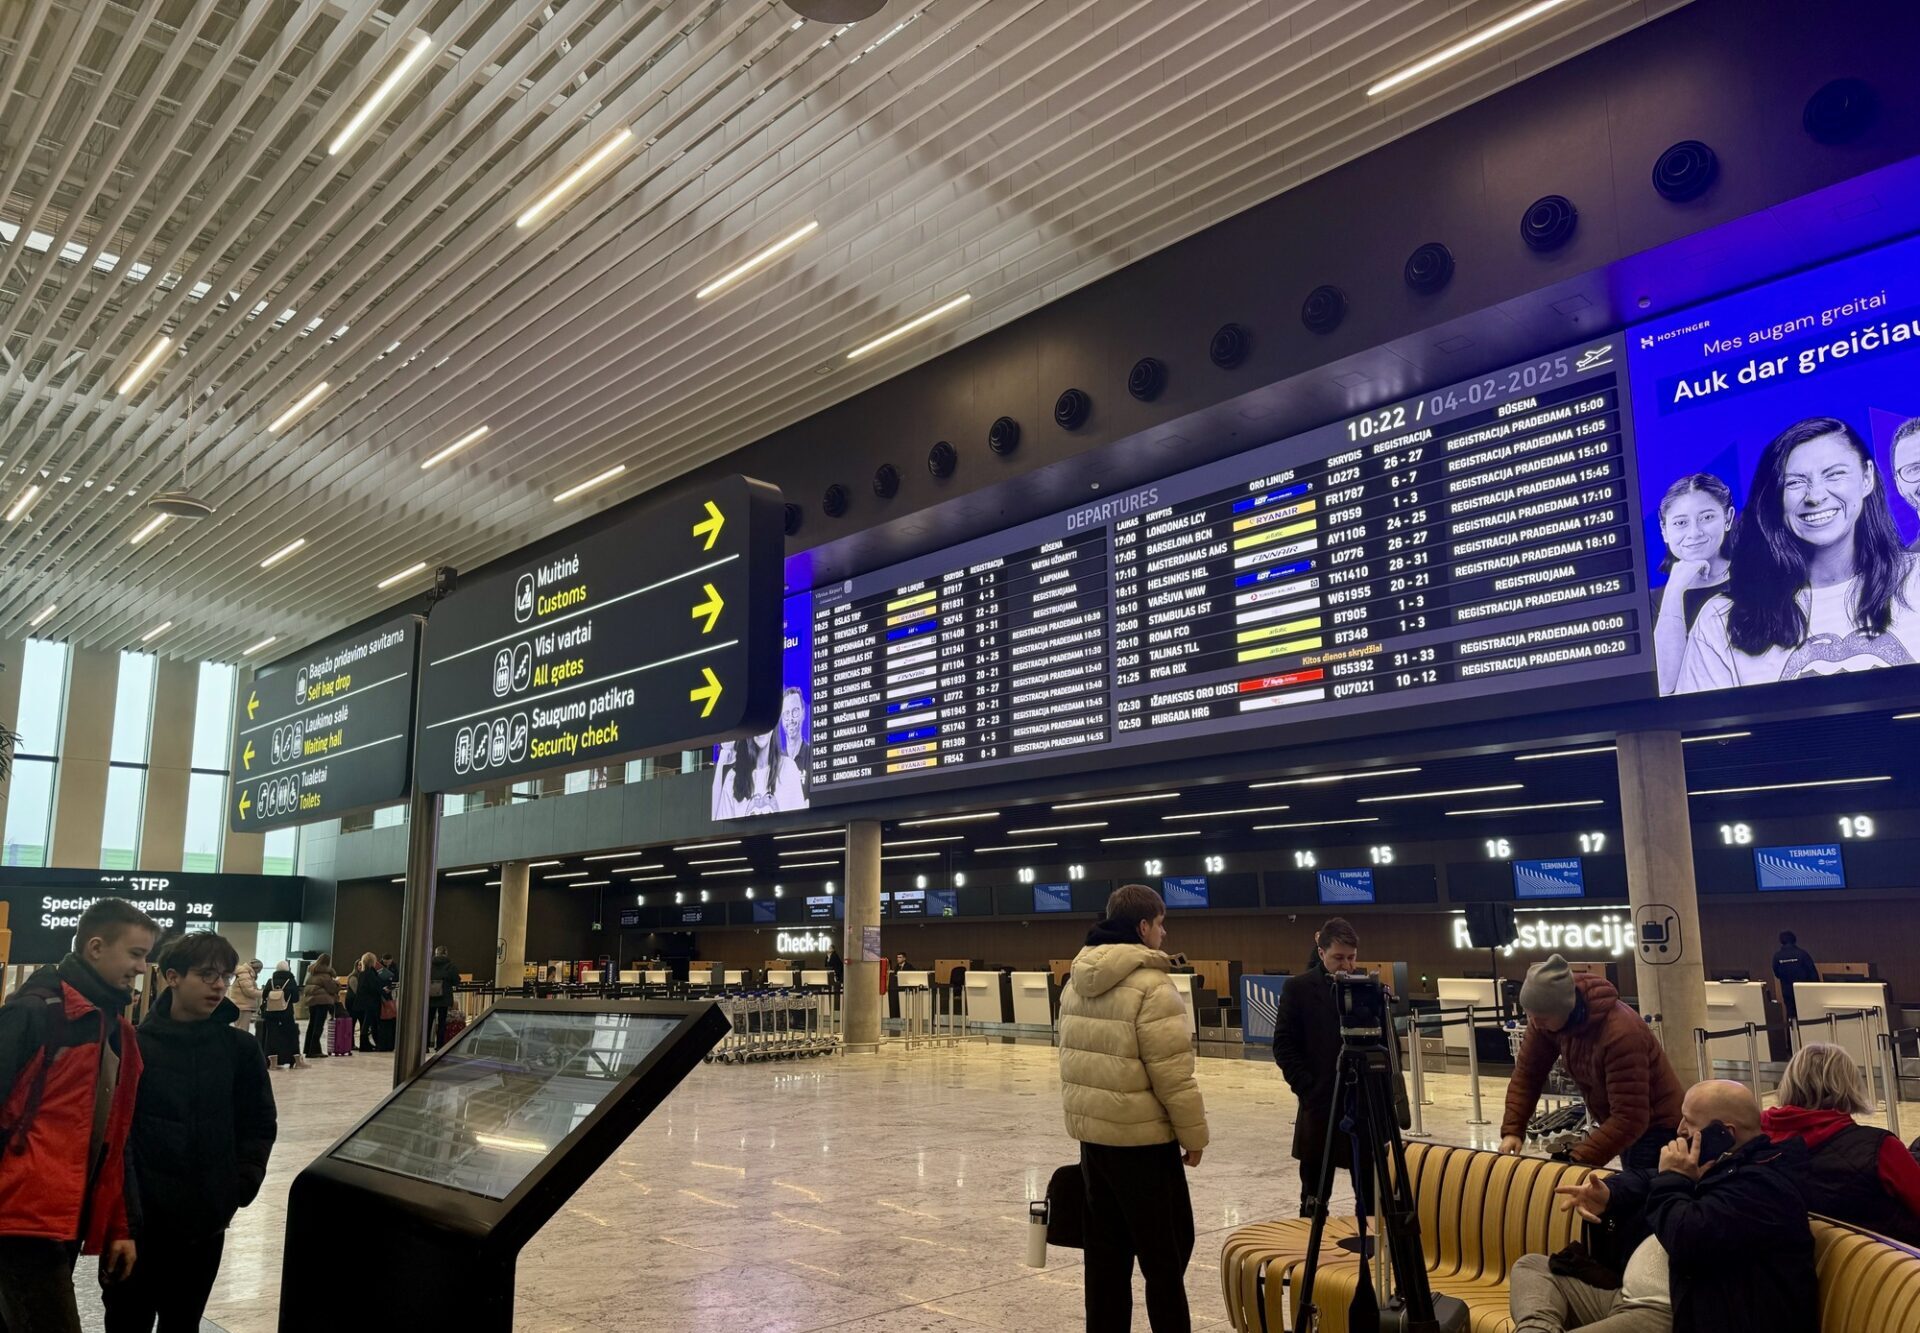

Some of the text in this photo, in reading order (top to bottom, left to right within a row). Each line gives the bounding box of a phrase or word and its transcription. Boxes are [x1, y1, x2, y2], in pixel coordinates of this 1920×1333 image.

[1657, 320, 1710, 342] HOSTINGER
[1704, 290, 1887, 356] Mes augam greitai
[1674, 370, 1729, 403] Auk
[1737, 356, 1789, 384] dar
[1348, 356, 1569, 442] 10:22 04-02-2025
[1114, 532, 1135, 546] 17:00
[1190, 512, 1205, 524] LCY
[1447, 425, 1510, 450] REGISTRACIJA
[1512, 407, 1571, 431] PRADEDAMA
[1574, 397, 1603, 413] 15:00
[1117, 397, 1536, 530] LAIKAS KRYPTIS ORO LINIJOS SKRYDIS REGISTRACIJA BŪSENA
[1115, 420, 1605, 563] 17:05 BARSELONA BCN RYANAIR FR1787 REGISTRACIJA PRADEDAMA 15:05
[1067, 488, 1158, 531] DEPARTURES
[1115, 442, 1607, 580] 17:10 AMSTERDAMAS AMS BT959 REGISTRACIJA PRADEDAMA 15:10
[1115, 465, 1609, 597] 18:15 HELSINKIS HEL FINNAIR AY1106 REGISTRACIJA PRADEDAMA 15:45
[1116, 601, 1137, 614] 19:10
[1148, 590, 1183, 607] VARŠUVA
[1185, 585, 1205, 598] WAW
[1452, 511, 1516, 533] REGISTRACIJA
[1518, 496, 1578, 518] PRADEDAMA
[1582, 487, 1611, 503] 17:10
[538, 554, 580, 588] Muitinė
[1116, 510, 1613, 632] 20:00 STAMBULAS IST TK1410 REGISTRACIJA PRADEDAMA 17:30
[538, 583, 586, 616] Customs
[1116, 533, 1615, 649] 20:10 ROMA FCO W61955 REGISTRACIJA PRADEDAMA 18:10
[942, 598, 963, 610] FR1831
[1116, 566, 1575, 667] 20:20 TALINAS TLL BT905 REGISTRUOJAMA
[534, 621, 592, 656] Visi vartai
[1117, 580, 1619, 684] 21:25 RYGA RIX BT348 REGISTRACIJA PRADEDAMA 19:25
[308, 628, 404, 679] Bagažo pridavimo savitarna
[1117, 700, 1140, 712] 02:30
[1196, 687, 1213, 698] ORO
[1215, 683, 1237, 695] UOST
[1333, 659, 1373, 675] U55392
[1460, 634, 1525, 653] REGISTRACIJA
[1528, 623, 1589, 642] PRADEDAMA
[1592, 617, 1622, 631] 00:00
[1302, 657, 1321, 666] Kitos
[1322, 651, 1346, 662] dienos
[534, 658, 584, 688] All gates
[942, 659, 964, 671] AY1104
[308, 674, 351, 701] Self bag drop
[1118, 640, 1625, 729] 02:50 HURGADA HRG QU7021 REGISTRACIJA PRADEDAMA 00:20
[305, 705, 348, 733] Laukimo salė
[532, 687, 635, 732] Saugumo patikra
[304, 729, 342, 756] Waiting hall
[530, 720, 619, 758] Security check
[942, 737, 964, 747] FR1309
[944, 753, 962, 763] FR542
[302, 766, 328, 786] Tualetai
[300, 792, 321, 810] Toilets
[1720, 824, 1752, 844] 18
[1838, 816, 1874, 838] 19
[1486, 839, 1510, 858] 16
[1580, 832, 1605, 852] 17
[1788, 848, 1836, 858] TERMINALAS
[1205, 856, 1224, 872] 13
[1294, 850, 1316, 868] 14
[1370, 846, 1392, 864] 15
[1540, 862, 1578, 870] TERMINALAS
[956, 872, 964, 886] 9
[1018, 868, 1034, 882] 10
[1068, 865, 1084, 880] 11
[1144, 860, 1162, 876] 12
[638, 895, 644, 906] 1
[675, 892, 683, 904] 2
[700, 890, 708, 902] 3
[746, 887, 754, 898] 4
[774, 885, 783, 898] 5
[130, 898, 176, 914] agalba
[776, 932, 832, 952] Check-in
